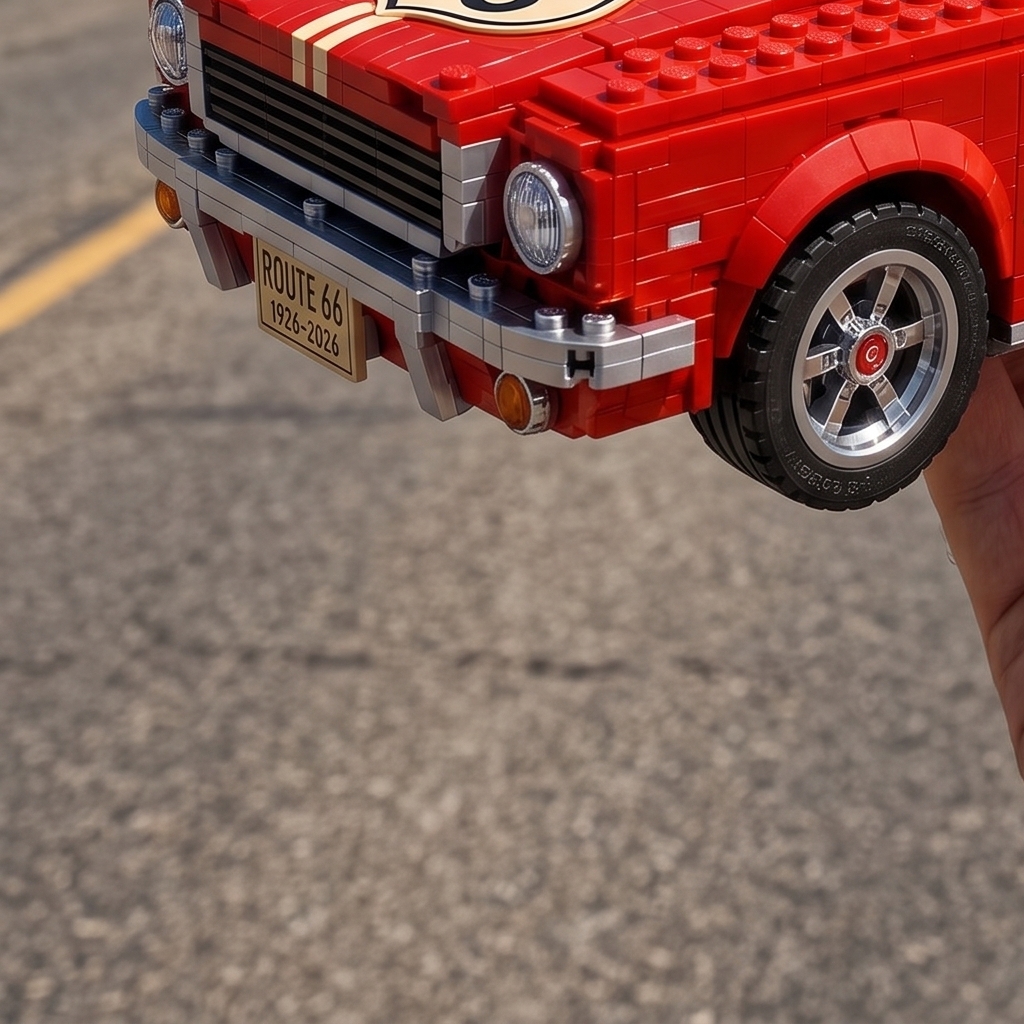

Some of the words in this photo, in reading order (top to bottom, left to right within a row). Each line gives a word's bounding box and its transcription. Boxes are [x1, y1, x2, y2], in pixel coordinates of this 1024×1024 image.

[262, 248, 317, 314] ROUTE
[321, 283, 343, 327] 66
[270, 299, 340, 358] 1926-2026
